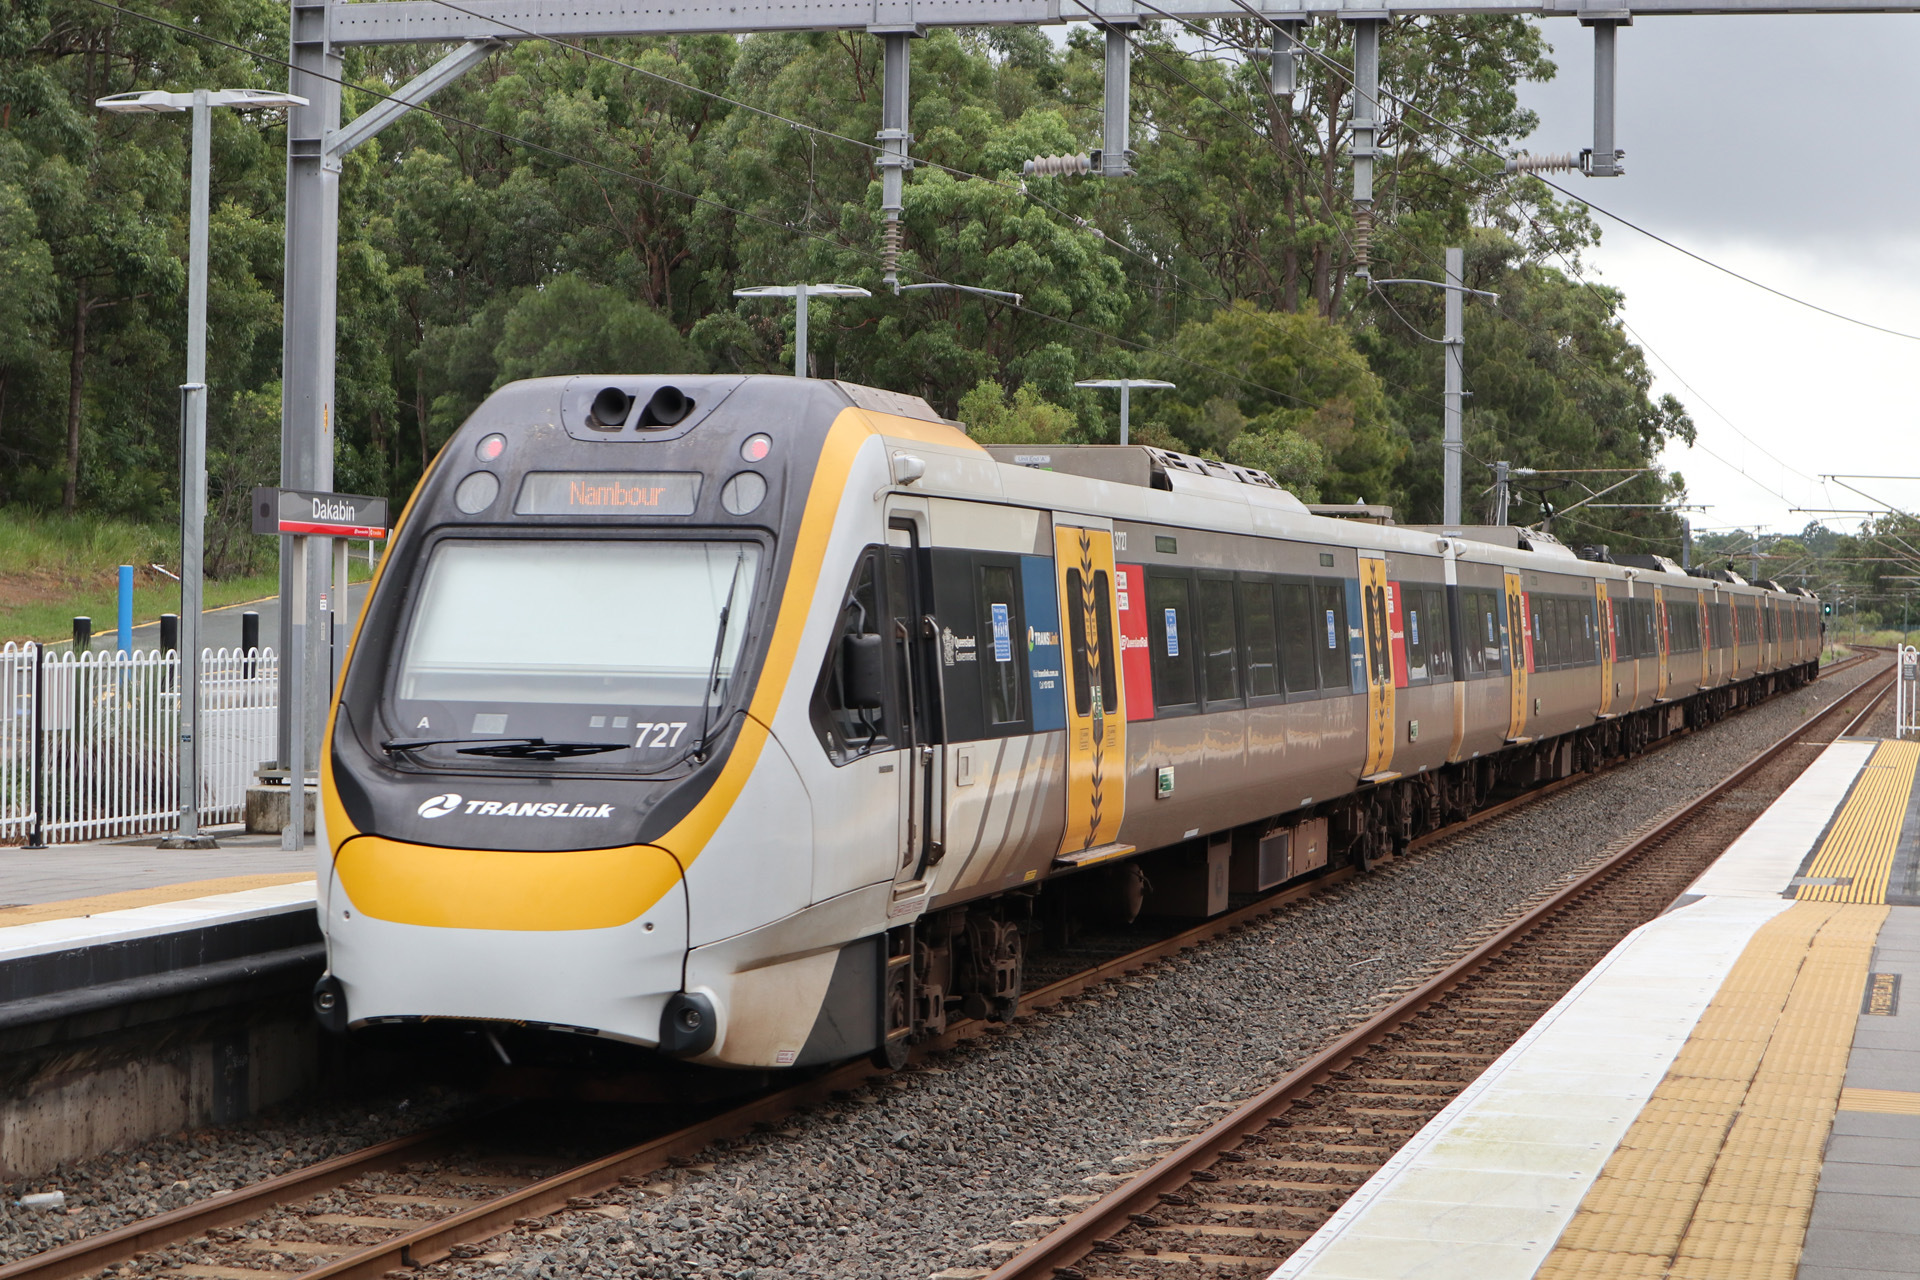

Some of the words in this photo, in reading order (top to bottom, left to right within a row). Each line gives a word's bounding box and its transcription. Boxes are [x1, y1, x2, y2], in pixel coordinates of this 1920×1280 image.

[570, 481, 666, 506] Nambour
[312, 497, 355, 522] Dakabin
[1114, 531, 1127, 551] 3727
[416, 716, 430, 729] A
[635, 722, 688, 748] 727
[464, 799, 616, 819] TRANSLink
